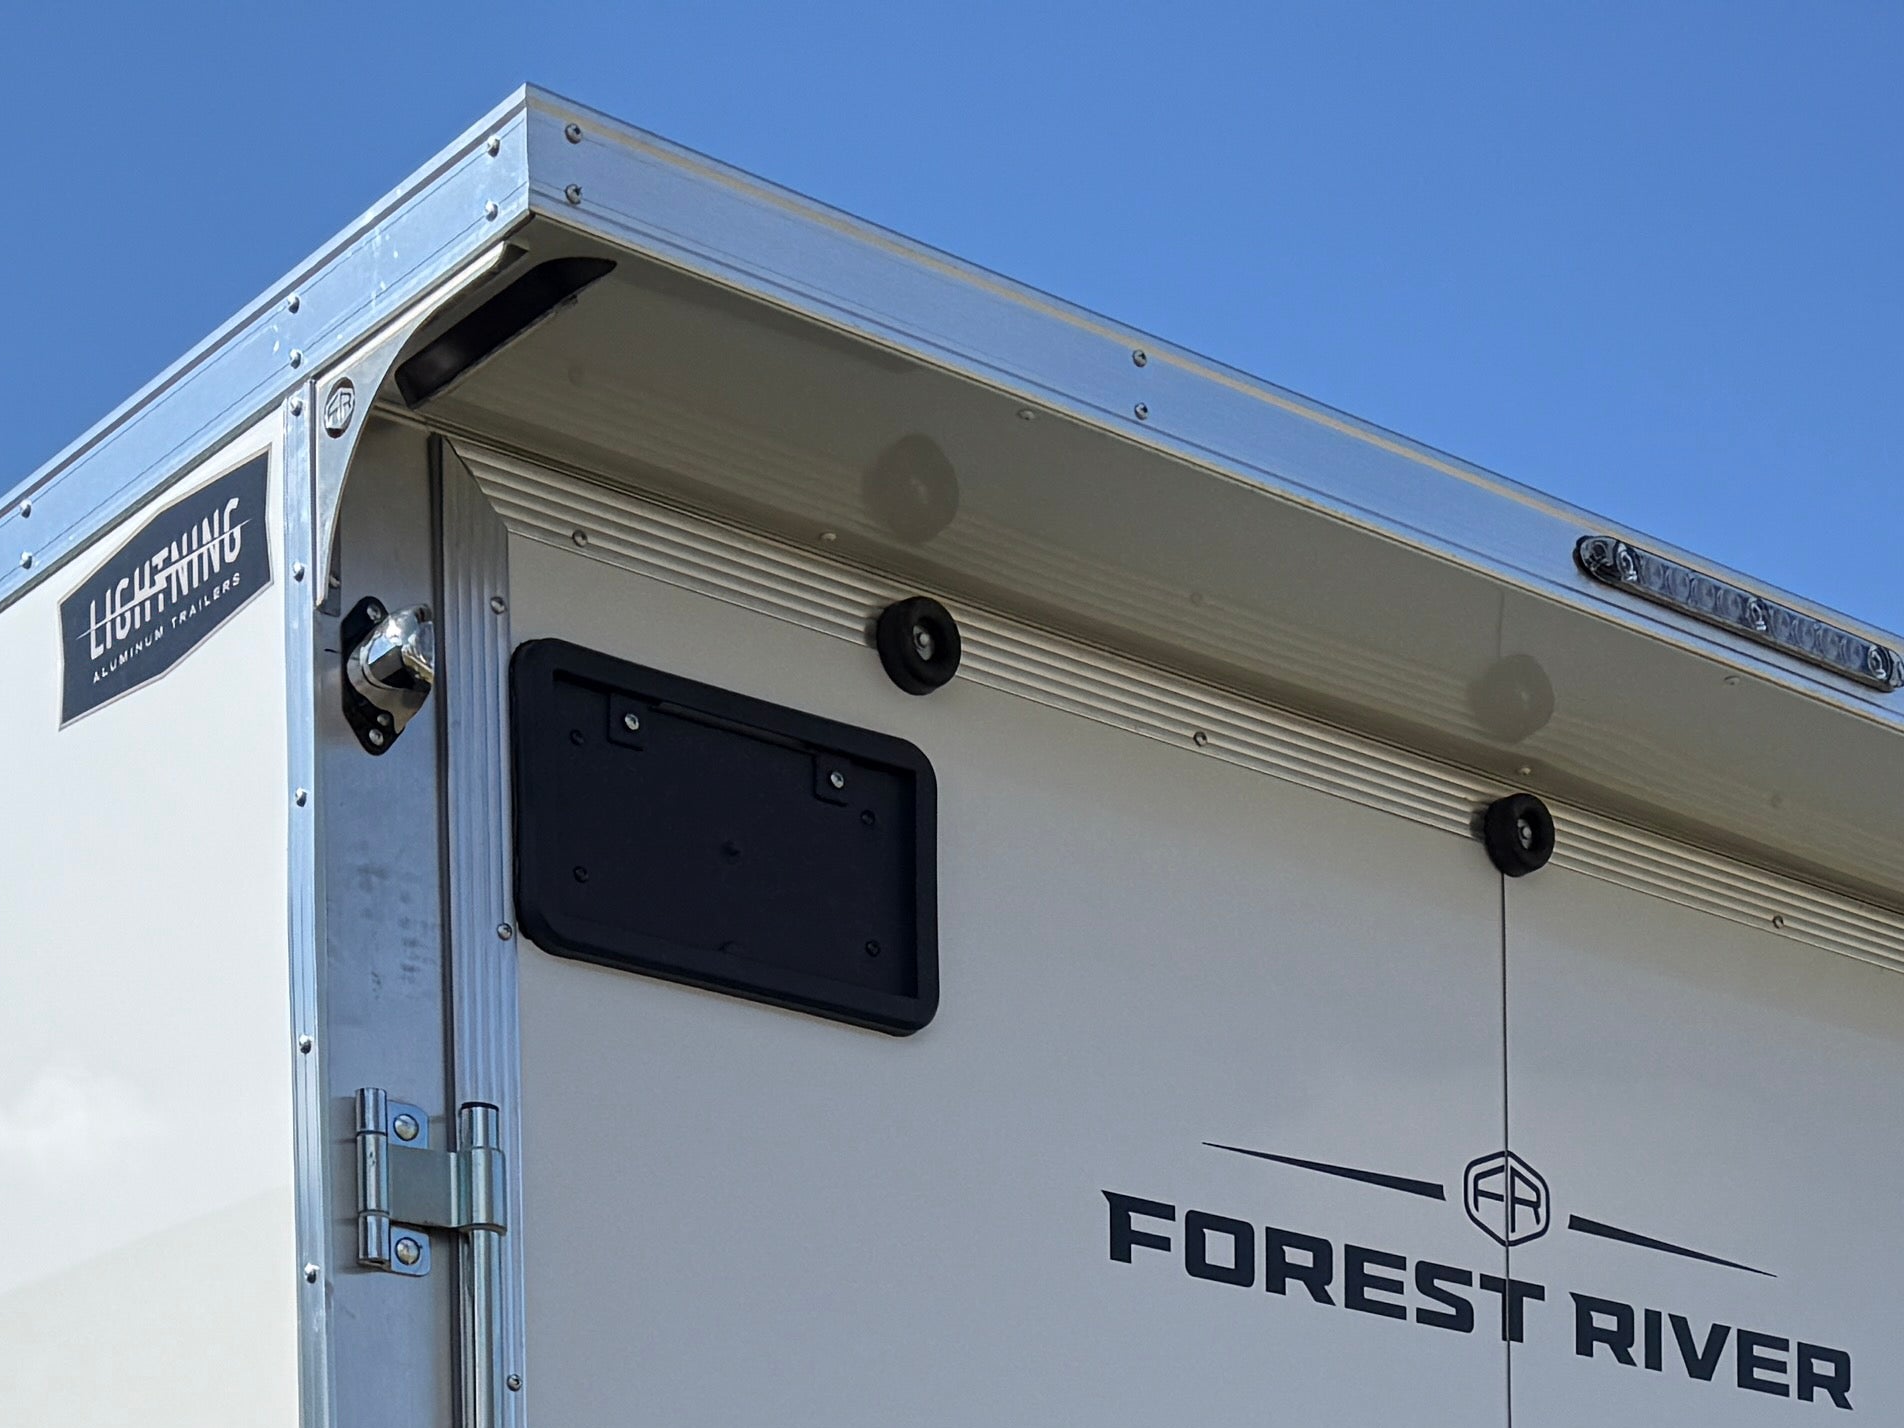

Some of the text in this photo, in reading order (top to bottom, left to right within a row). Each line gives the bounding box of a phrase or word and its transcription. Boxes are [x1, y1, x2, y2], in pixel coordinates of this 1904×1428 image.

[89, 497, 243, 660] LIGHTNING
[92, 572, 241, 684] ALUMINUM TRAILERS
[1100, 1189, 1854, 1411] FOREST RIVER
